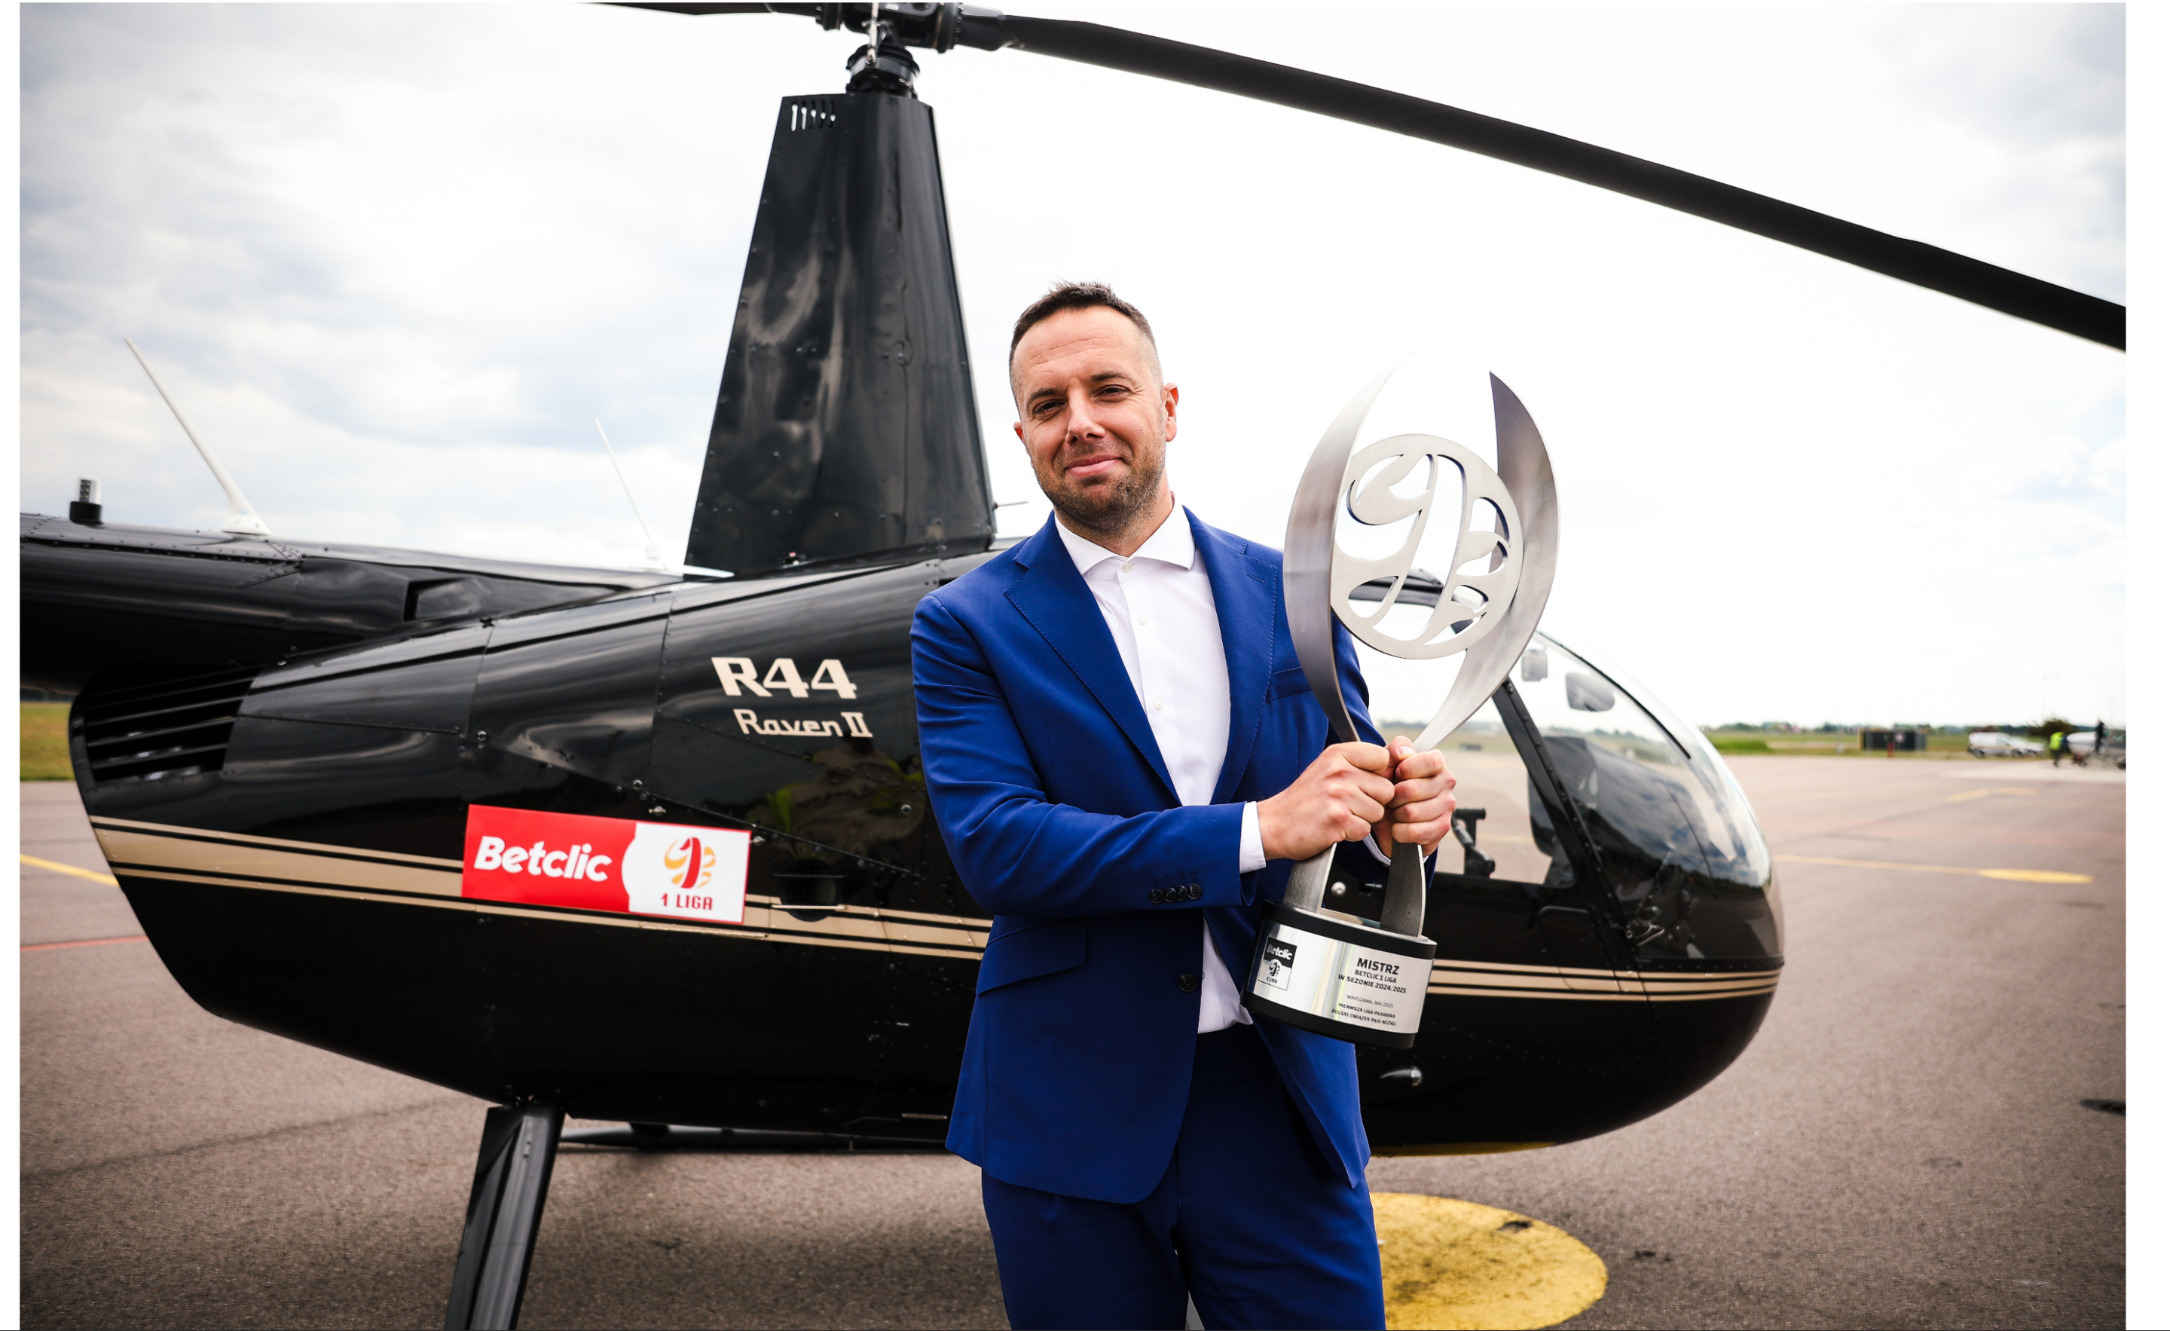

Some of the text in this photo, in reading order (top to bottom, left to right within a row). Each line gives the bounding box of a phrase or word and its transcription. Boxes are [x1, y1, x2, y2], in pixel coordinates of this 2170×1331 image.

[711, 656, 858, 699] R44
[733, 708, 873, 738] Raven II
[474, 835, 613, 882] Betclic
[660, 893, 714, 911] 1 LIGA
[1266, 943, 1293, 960] Betclic
[1357, 957, 1400, 976] MISTRZ
[1338, 973, 1345, 981] W
[1346, 975, 1374, 988] SEZONIE
[1354, 969, 1380, 980] BETCLIC
[1384, 976, 1397, 984] LIGA
